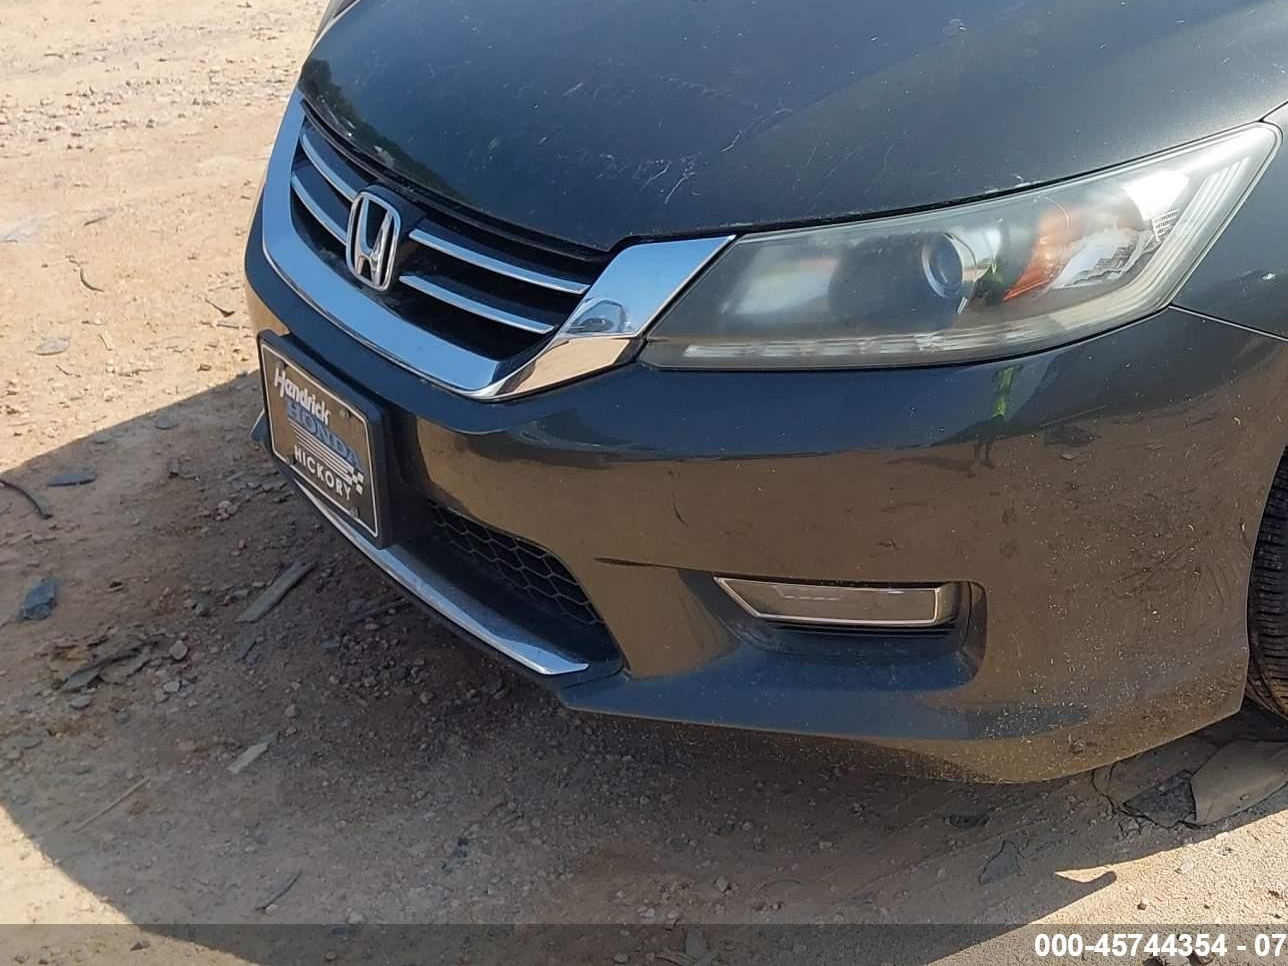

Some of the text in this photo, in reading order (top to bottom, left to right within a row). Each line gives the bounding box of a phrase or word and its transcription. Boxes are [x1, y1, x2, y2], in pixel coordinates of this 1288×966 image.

[274, 367, 331, 425] Hendrick
[287, 400, 364, 469] HONDA
[294, 444, 352, 501] HICKORY
